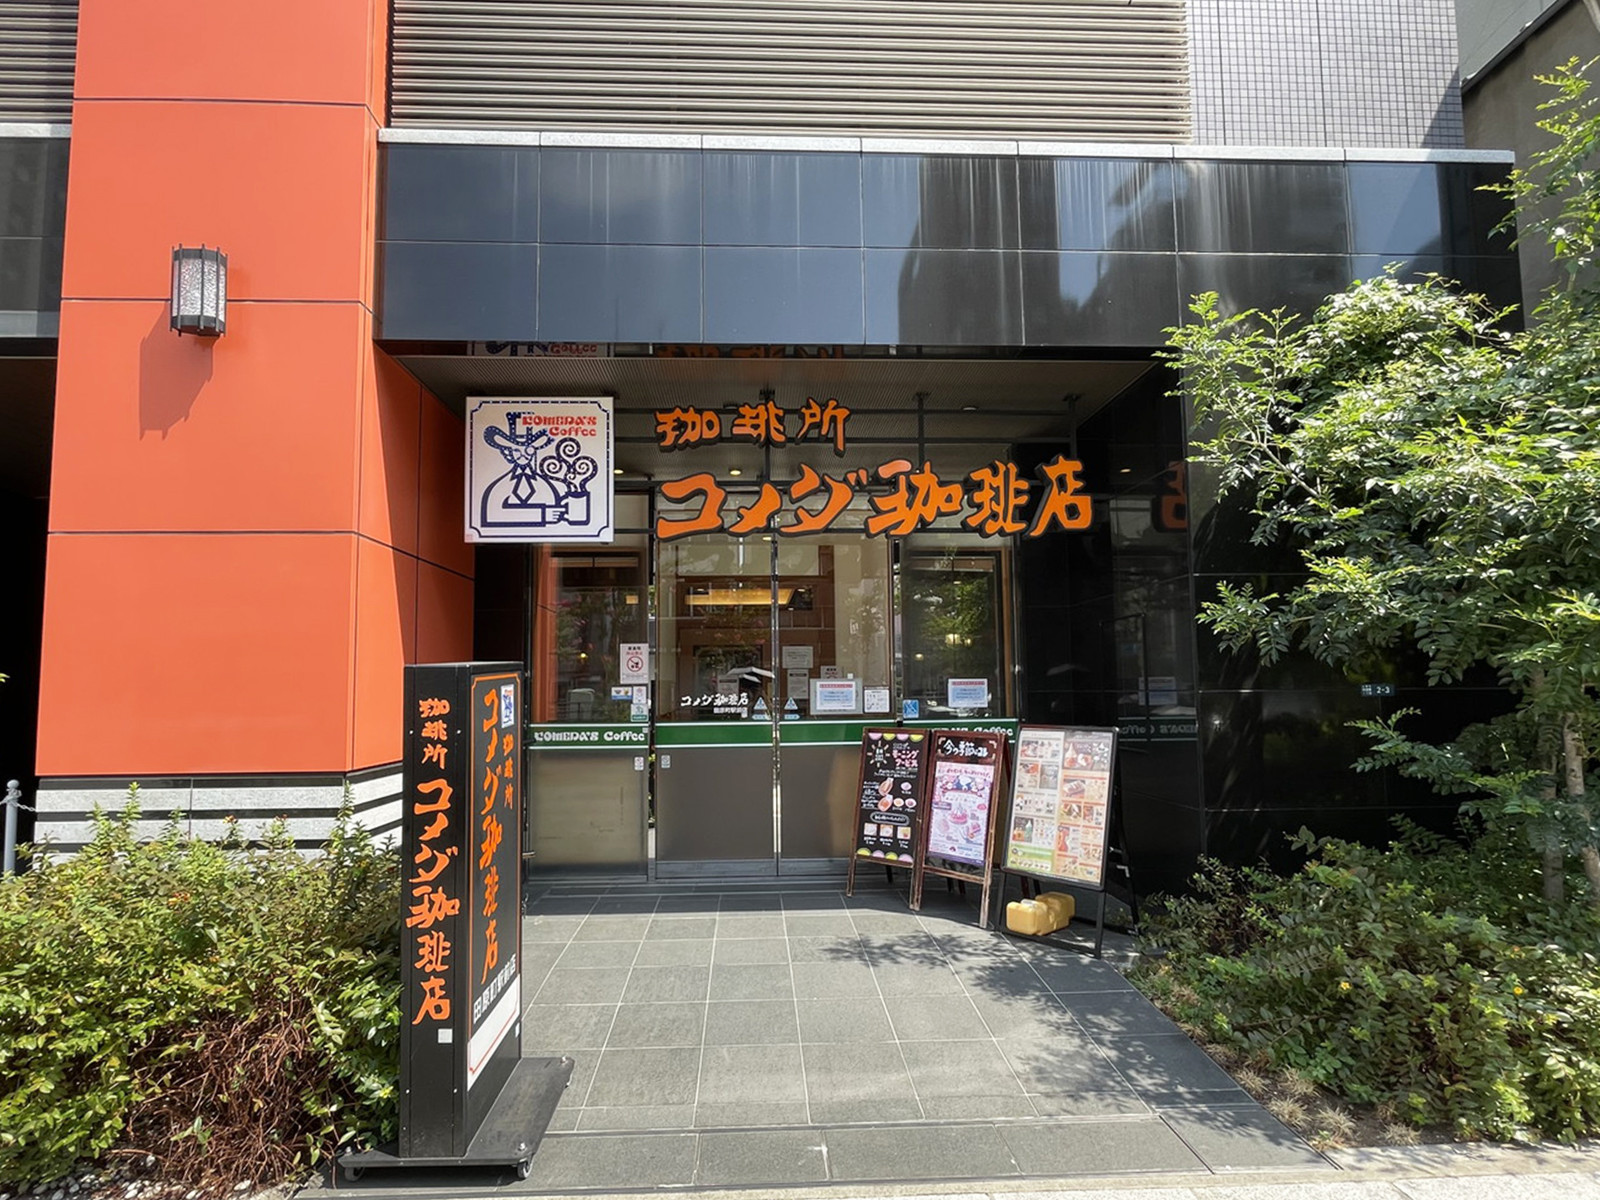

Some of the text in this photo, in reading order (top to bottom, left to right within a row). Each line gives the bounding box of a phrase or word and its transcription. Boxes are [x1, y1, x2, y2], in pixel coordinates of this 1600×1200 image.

[521, 415, 597, 426] KOMEDA'S
[549, 426, 597, 437] Coffee
[657, 400, 850, 450] 珈琲所
[657, 457, 1092, 539] コメダ珈琲店
[418, 697, 451, 769] 珈琲所
[534, 730, 646, 742] KOMEDA'S Coffee
[480, 688, 504, 984] コメダ珈琲店
[406, 778, 460, 1026] コメダ珈琲店
